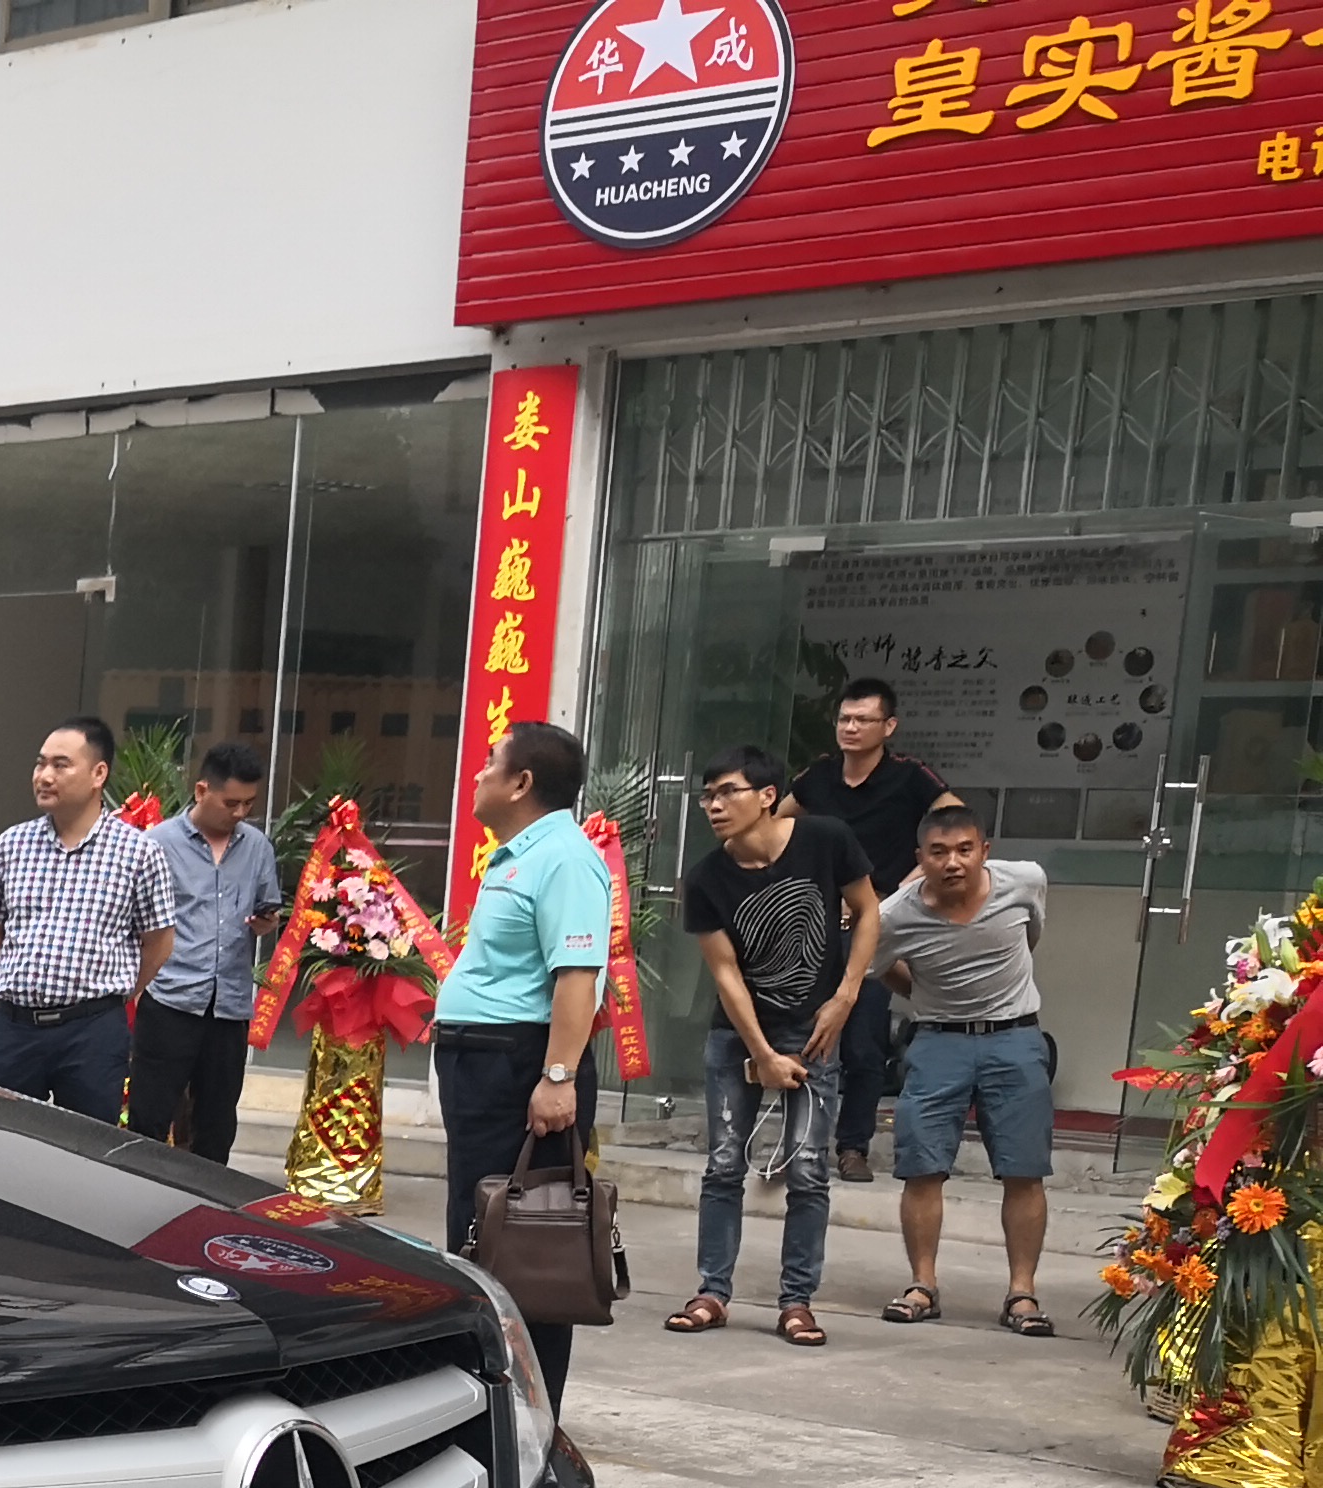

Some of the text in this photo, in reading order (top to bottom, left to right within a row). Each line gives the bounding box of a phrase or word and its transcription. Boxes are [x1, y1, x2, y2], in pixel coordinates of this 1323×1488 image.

[866, 0, 1323, 148] 皇实酱
[595, 174, 711, 207] HUACHENG
